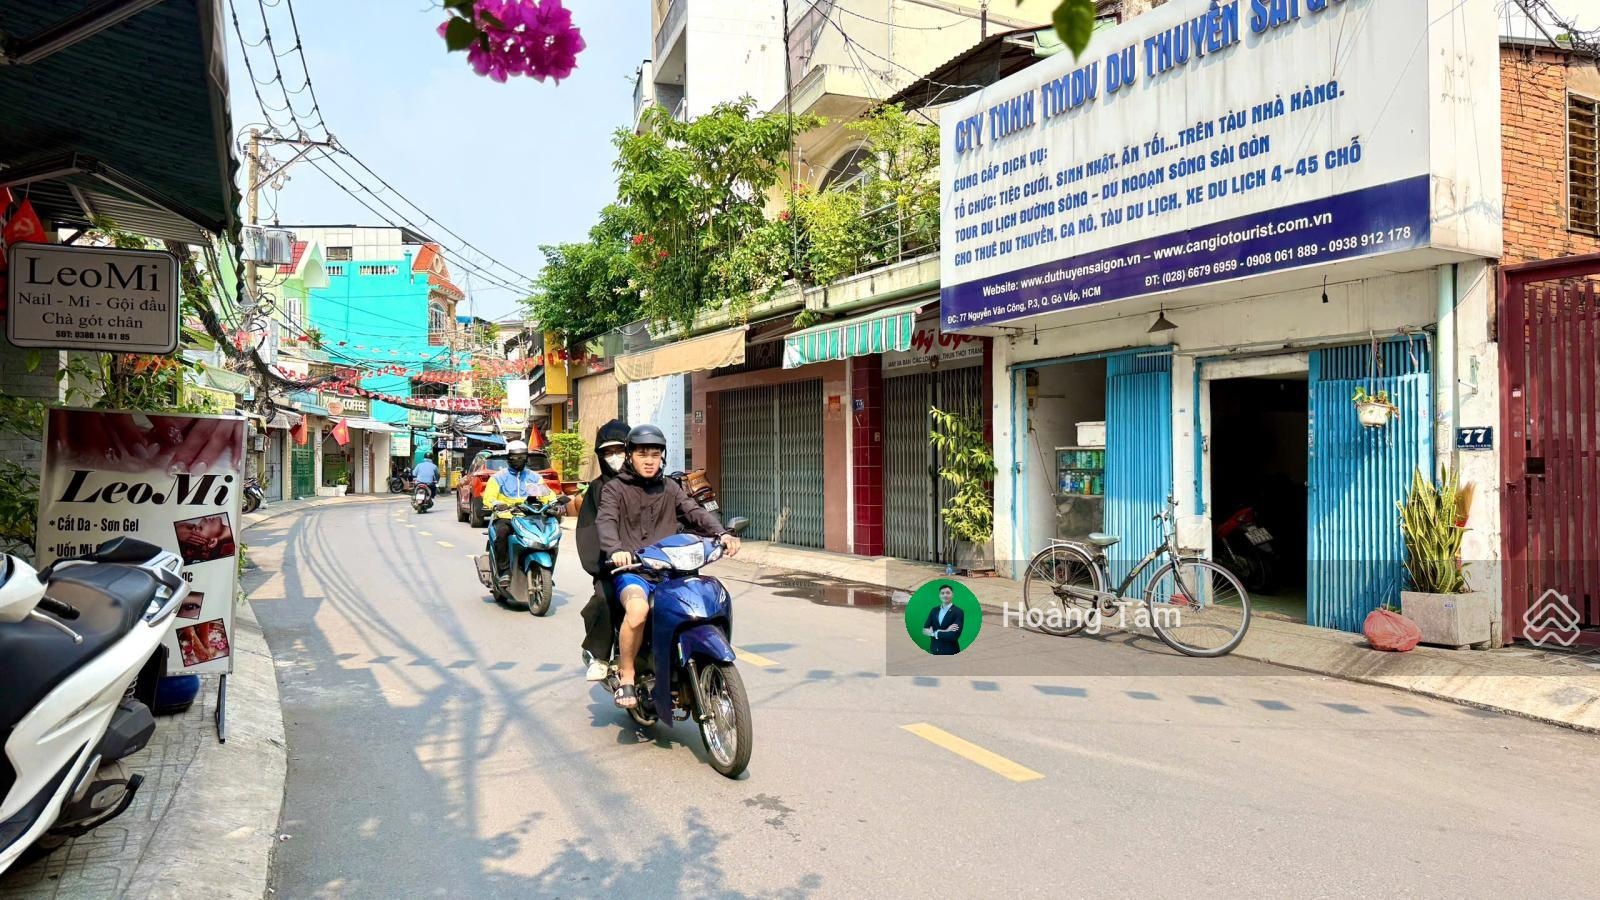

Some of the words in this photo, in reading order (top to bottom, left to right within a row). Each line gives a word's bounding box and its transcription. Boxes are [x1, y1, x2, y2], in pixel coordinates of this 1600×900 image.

[955, 112, 984, 154] CTY
[989, 89, 1036, 141] TNHH
[1040, 60, 1099, 119] TMDV
[1106, 44, 1137, 94] DU
[954, 198, 965, 221] TỔ
[968, 193, 997, 217] CHỨC:
[999, 186, 1021, 206] TIỆC
[1056, 164, 1083, 187] SINH
[1121, 145, 1140, 166] ĂN
[1218, 110, 1247, 135] TÀU
[1252, 94, 1284, 124] NHÀ
[1290, 80, 1345, 112] HÀNG.
[954, 173, 978, 193] CUNG
[980, 160, 1000, 184] CẤP
[1002, 154, 1027, 177] DỊCH
[1029, 148, 1048, 167] VỤ:
[955, 224, 978, 244] TOUR
[980, 220, 993, 236] DU
[995, 212, 1017, 233] LỊCH
[1019, 200, 1055, 224] ĐƯỜNG
[1057, 190, 1088, 214] SÔNG
[1102, 184, 1118, 201] DU
[1121, 166, 1165, 195] NGOẠN
[1168, 155, 1206, 181] SÔNG
[1210, 144, 1235, 168] SÀI
[1238, 134, 1270, 161] GÒN
[954, 251, 973, 267] CHO
[974, 241, 997, 262] THUÊ
[999, 239, 1013, 256] DU
[1060, 222, 1075, 240] CA
[1101, 206, 1123, 229] TÀU
[1126, 204, 1144, 222] DU
[1186, 186, 1208, 206] XE
[1208, 180, 1228, 201] DU
[1231, 168, 1266, 195] LỊCH
[1324, 135, 1363, 171] CHỖ
[983, 282, 1019, 298] Website:
[1020, 252, 1141, 289] www.duthuyensaigon.vn
[1153, 210, 1333, 262] www.cangiotourist.com.vn
[1145, 274, 1160, 288] ĐT:
[1162, 269, 1186, 286] (028)
[1188, 263, 1211, 280] 6679
[1213, 259, 1237, 274] 6959
[1246, 251, 1272, 268] 0908
[1274, 247, 1294, 263] 061
[1297, 243, 1318, 259] 889
[1328, 235, 1358, 254] 0938
[1360, 230, 1384, 248] 912
[1387, 225, 1412, 243] 178
[24, 256, 161, 292] LeoMi
[18, 292, 51, 307] Nail
[68, 294, 90, 309] Mi
[106, 297, 135, 313] Gội
[139, 296, 168, 313] đầu
[42, 311, 73, 326] Chà
[78, 315, 103, 329] gót
[107, 315, 144, 329] chân
[947, 314, 959, 325] ĐC:
[959, 312, 967, 322] 77
[968, 306, 992, 322] Nguyễn
[992, 305, 1006, 315] Văn
[1006, 300, 1027, 314] Công,
[1027, 298, 1041, 310] P.3,
[1041, 295, 1050, 306] Q.
[1063, 289, 1081, 303] Vấp,
[1082, 286, 1101, 298] HCM
[343, 398, 367, 412] COFFEE
[1461, 429, 1487, 444] 77
[57, 514, 75, 532] Cắt
[77, 517, 91, 532] Da
[100, 517, 120, 532] Sơn
[122, 518, 139, 532] Gel
[56, 541, 77, 558] Uốn
[79, 543, 93, 557] Mi
